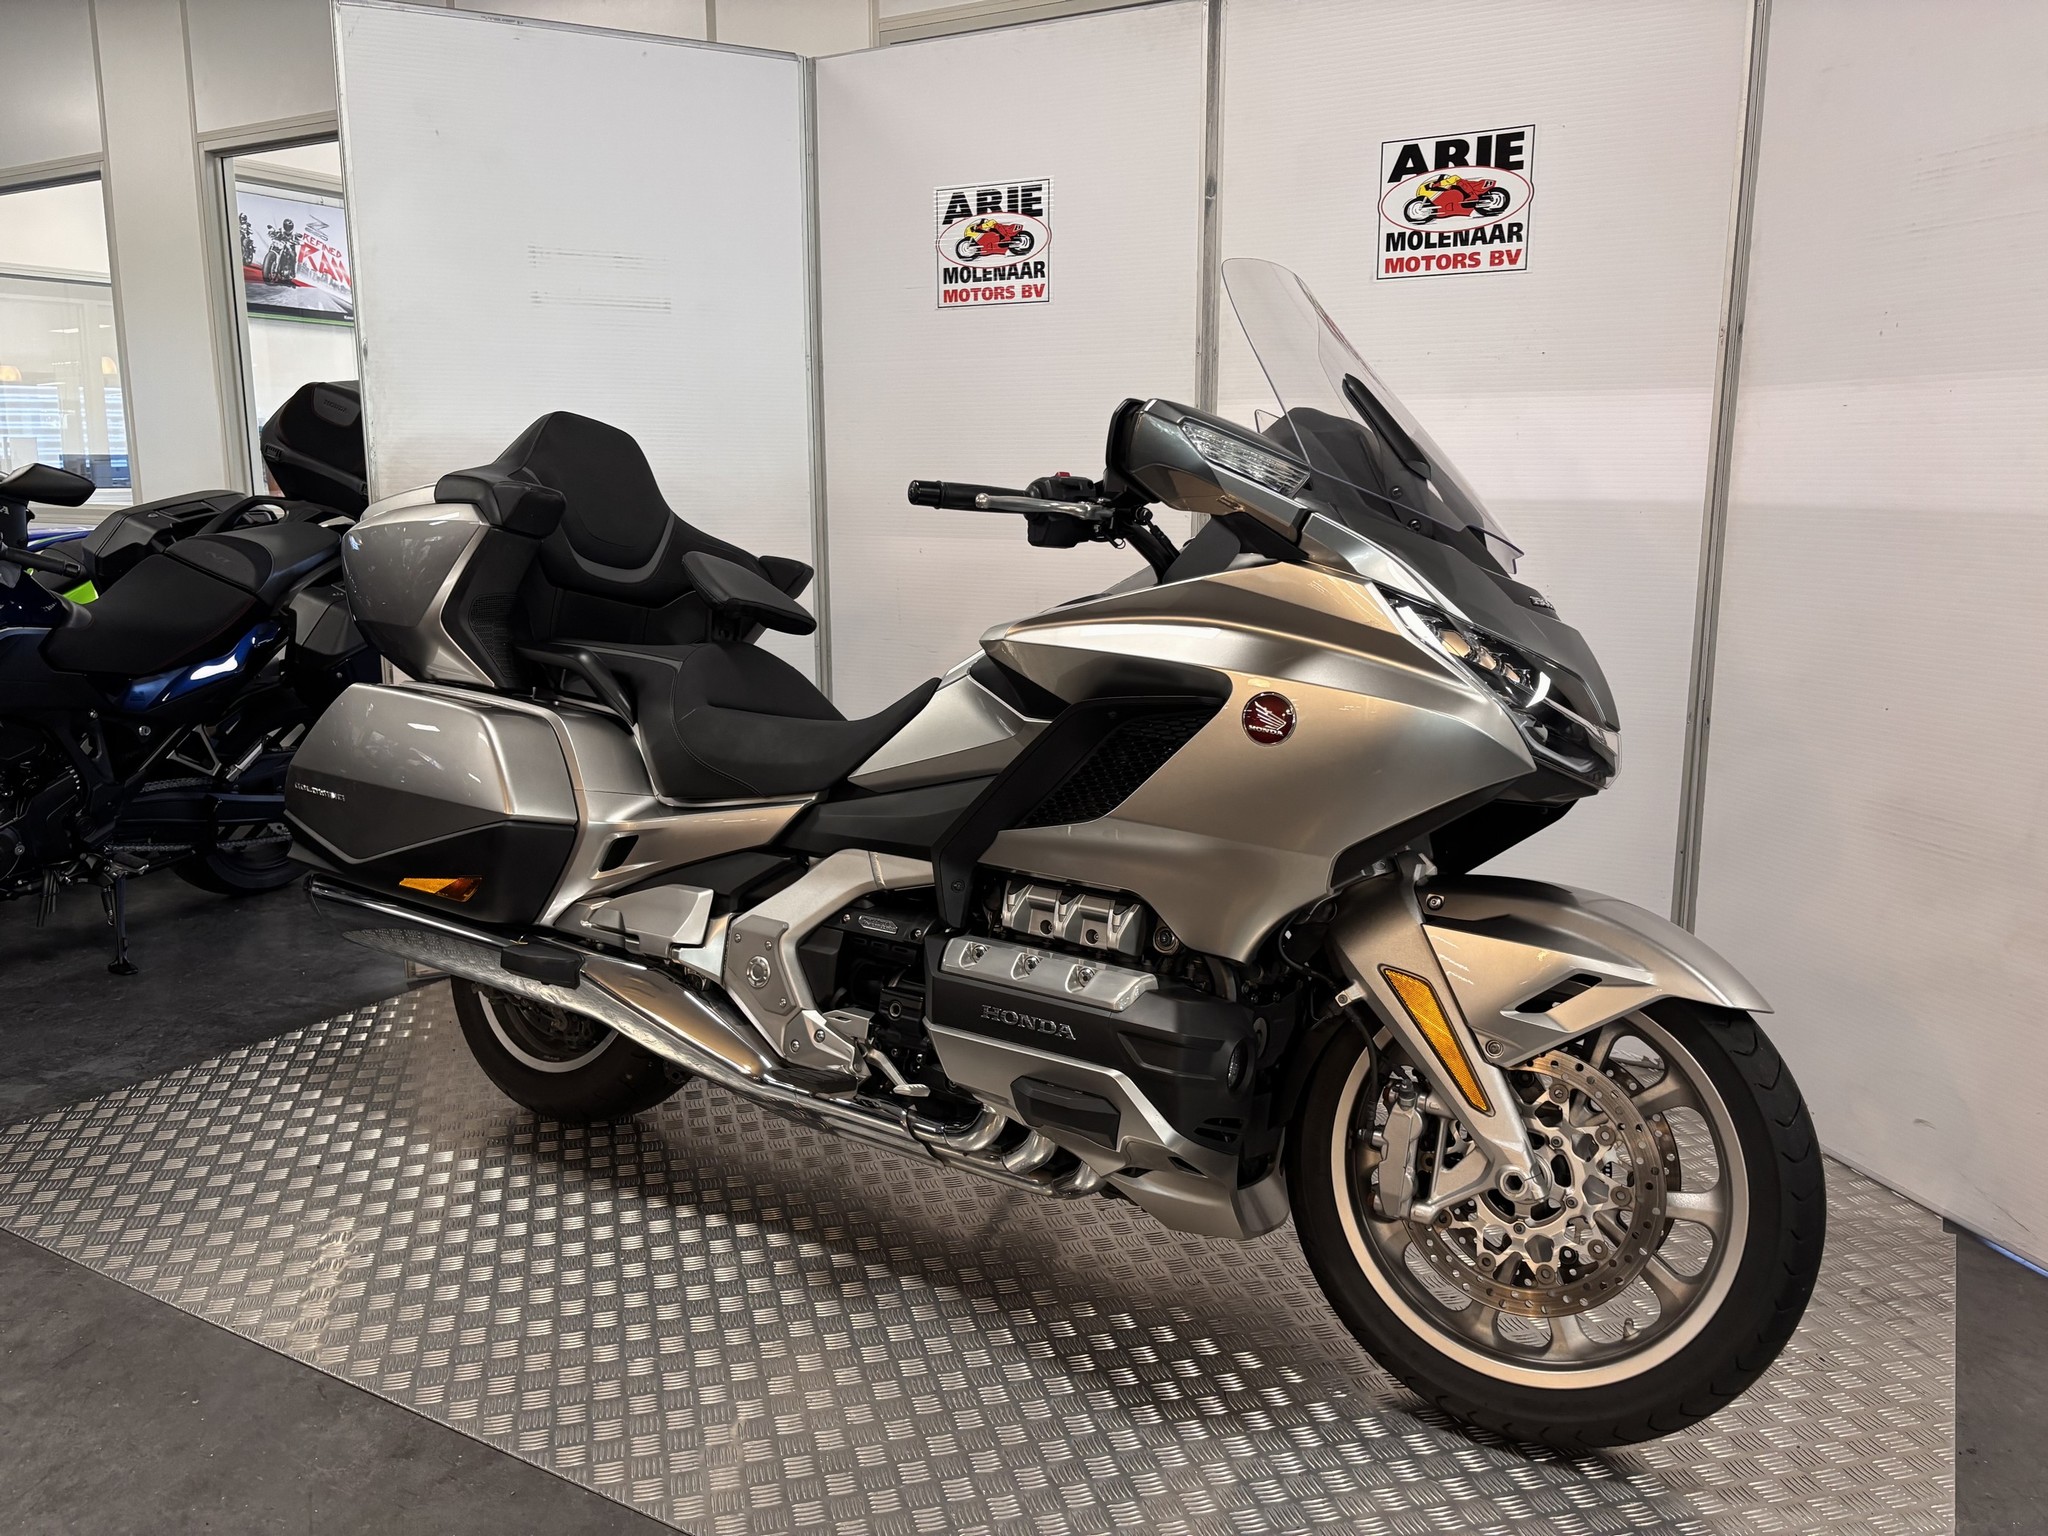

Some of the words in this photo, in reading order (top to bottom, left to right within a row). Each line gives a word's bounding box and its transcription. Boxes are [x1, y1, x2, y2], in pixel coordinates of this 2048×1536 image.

[1387, 131, 1525, 183] ARIE
[942, 184, 1043, 225] ARIE
[302, 231, 342, 258] REFINED
[1385, 222, 1524, 252] MOLENAAR
[943, 261, 1046, 285] MOLENAAR
[1384, 252, 1481, 274] MOTORS
[1489, 249, 1523, 267] BV
[943, 285, 1016, 303] MOTORS
[1021, 284, 1046, 298] BV
[1248, 725, 1284, 736] HONDA
[980, 1004, 1077, 1041] HONDA
